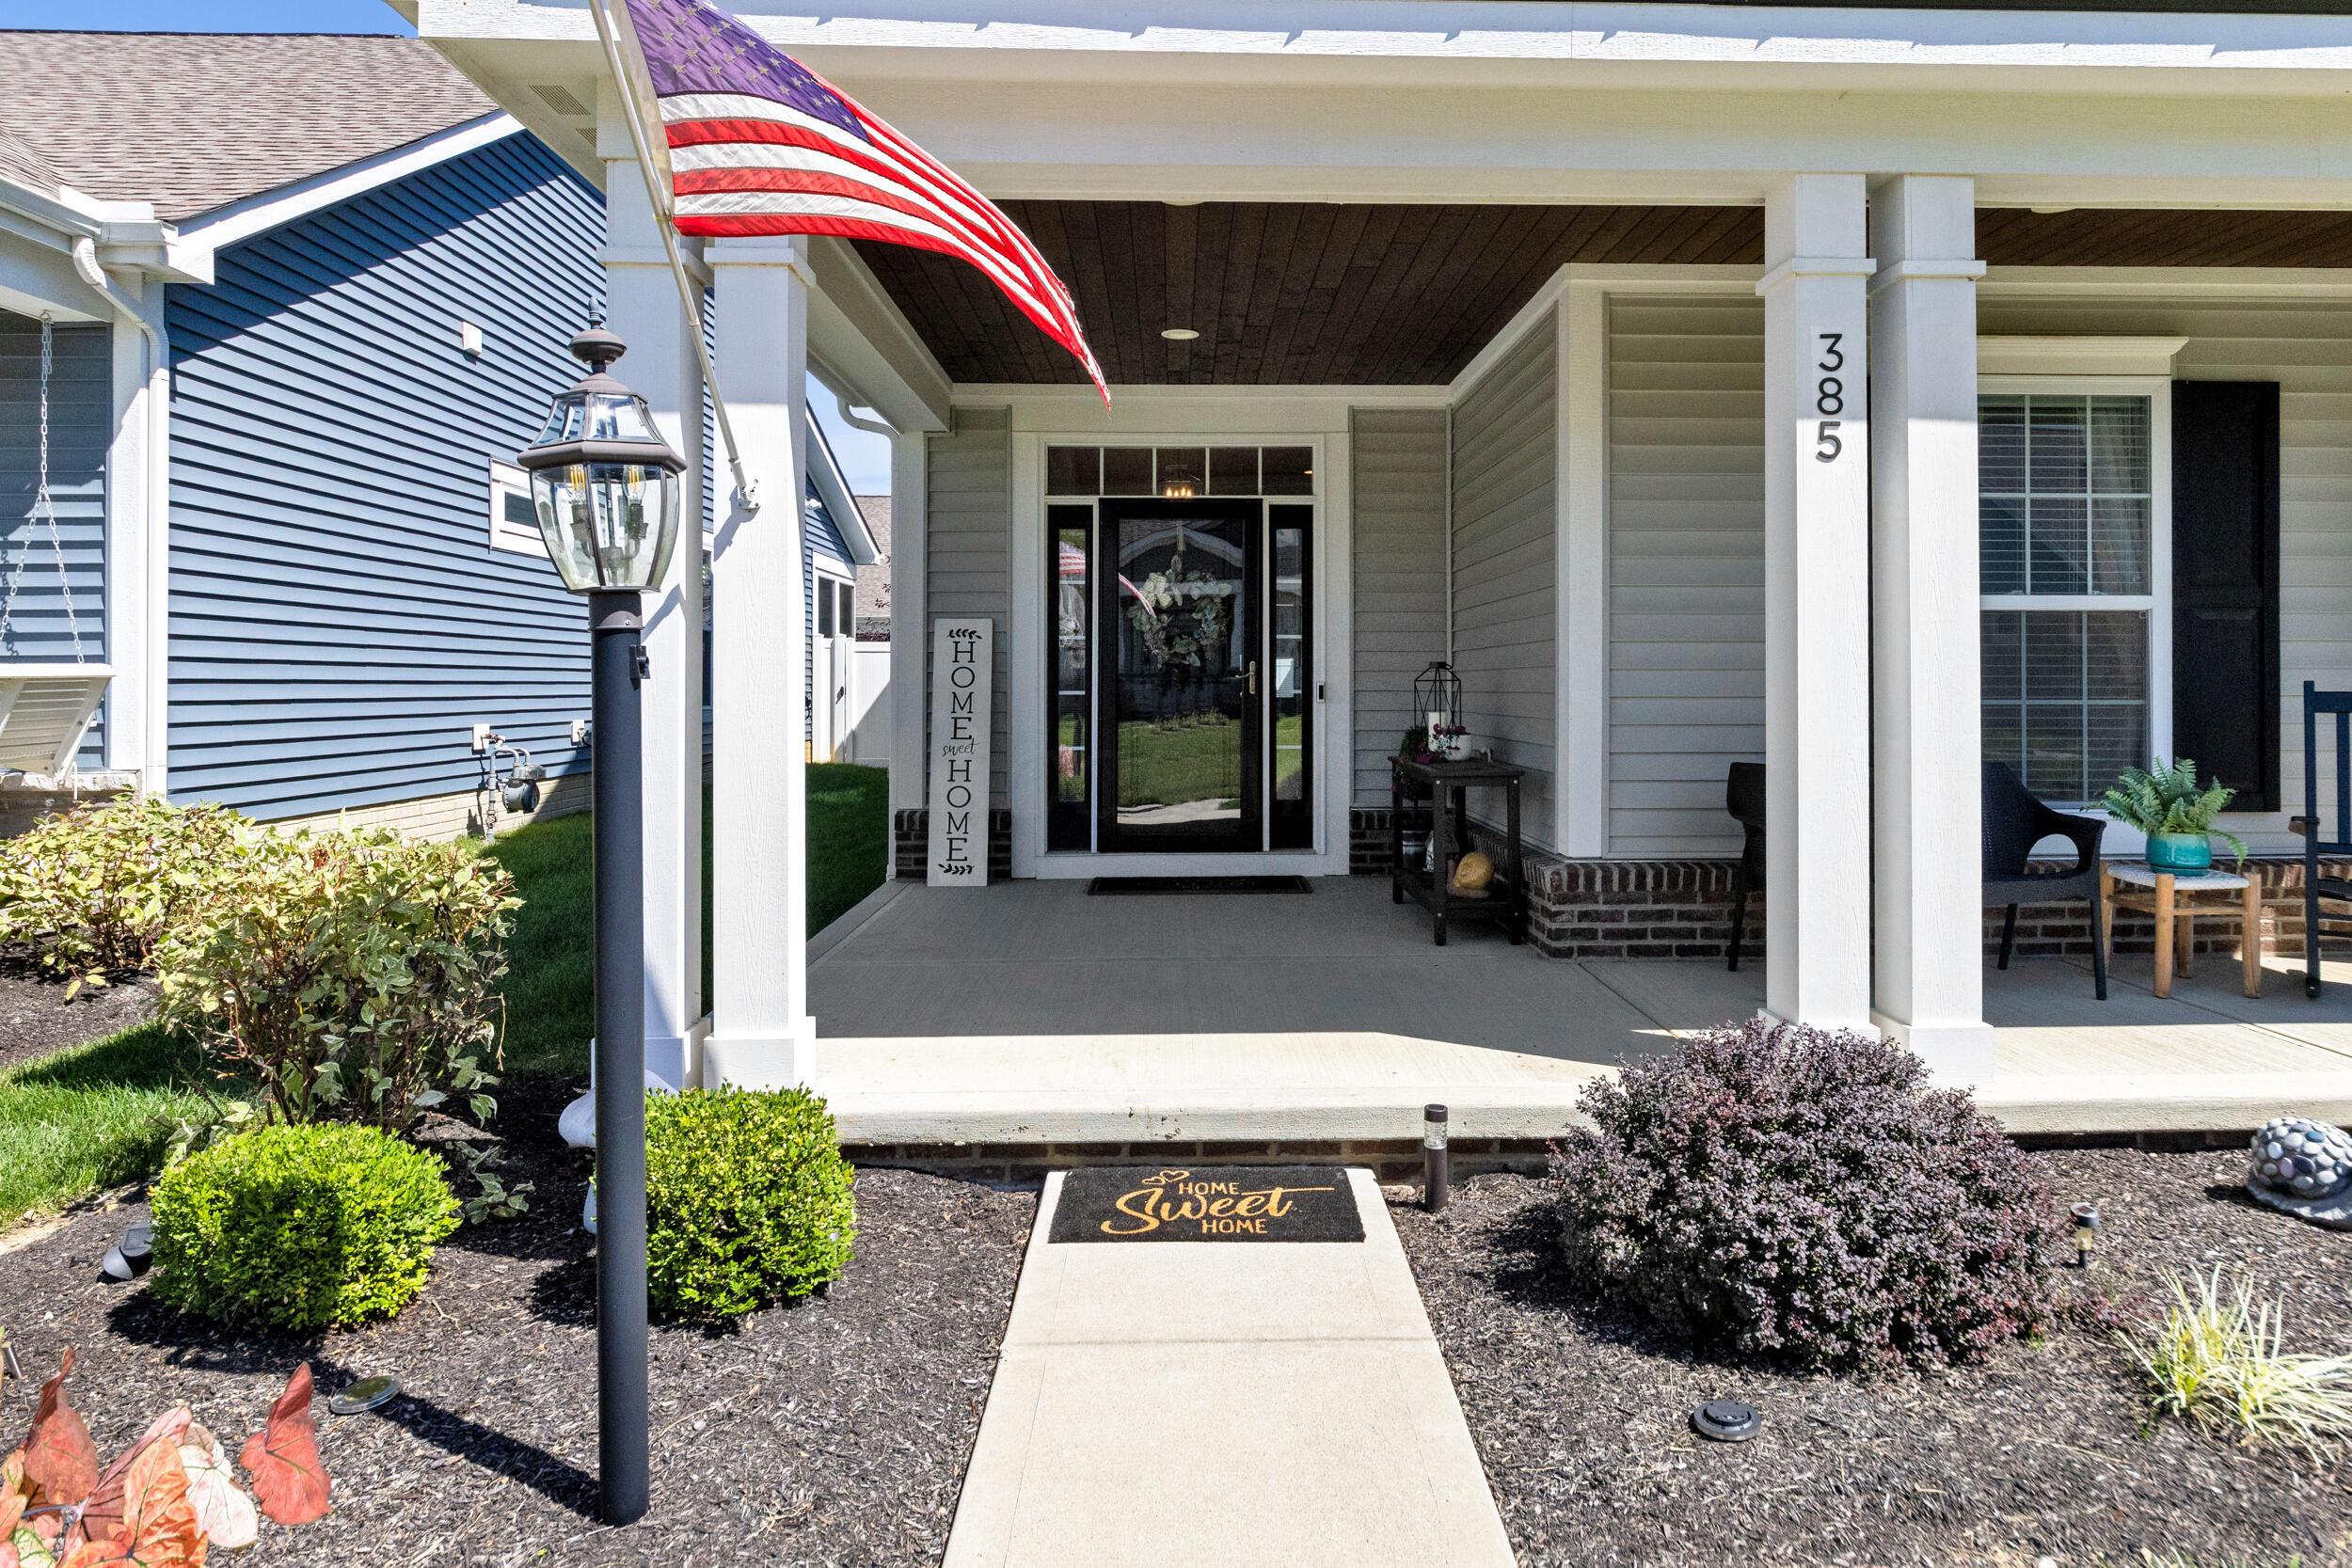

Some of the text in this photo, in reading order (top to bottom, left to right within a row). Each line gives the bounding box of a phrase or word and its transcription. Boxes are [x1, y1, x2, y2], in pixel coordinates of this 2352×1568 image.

[1817, 333, 1844, 461] 385
[951, 641, 976, 739] HOME
[943, 737, 977, 757] sweet
[946, 759, 972, 862] HOME
[1100, 1186, 1335, 1235] Sweet
[1178, 1181, 1240, 1196] HOME
[1201, 1219, 1267, 1234] HOME
